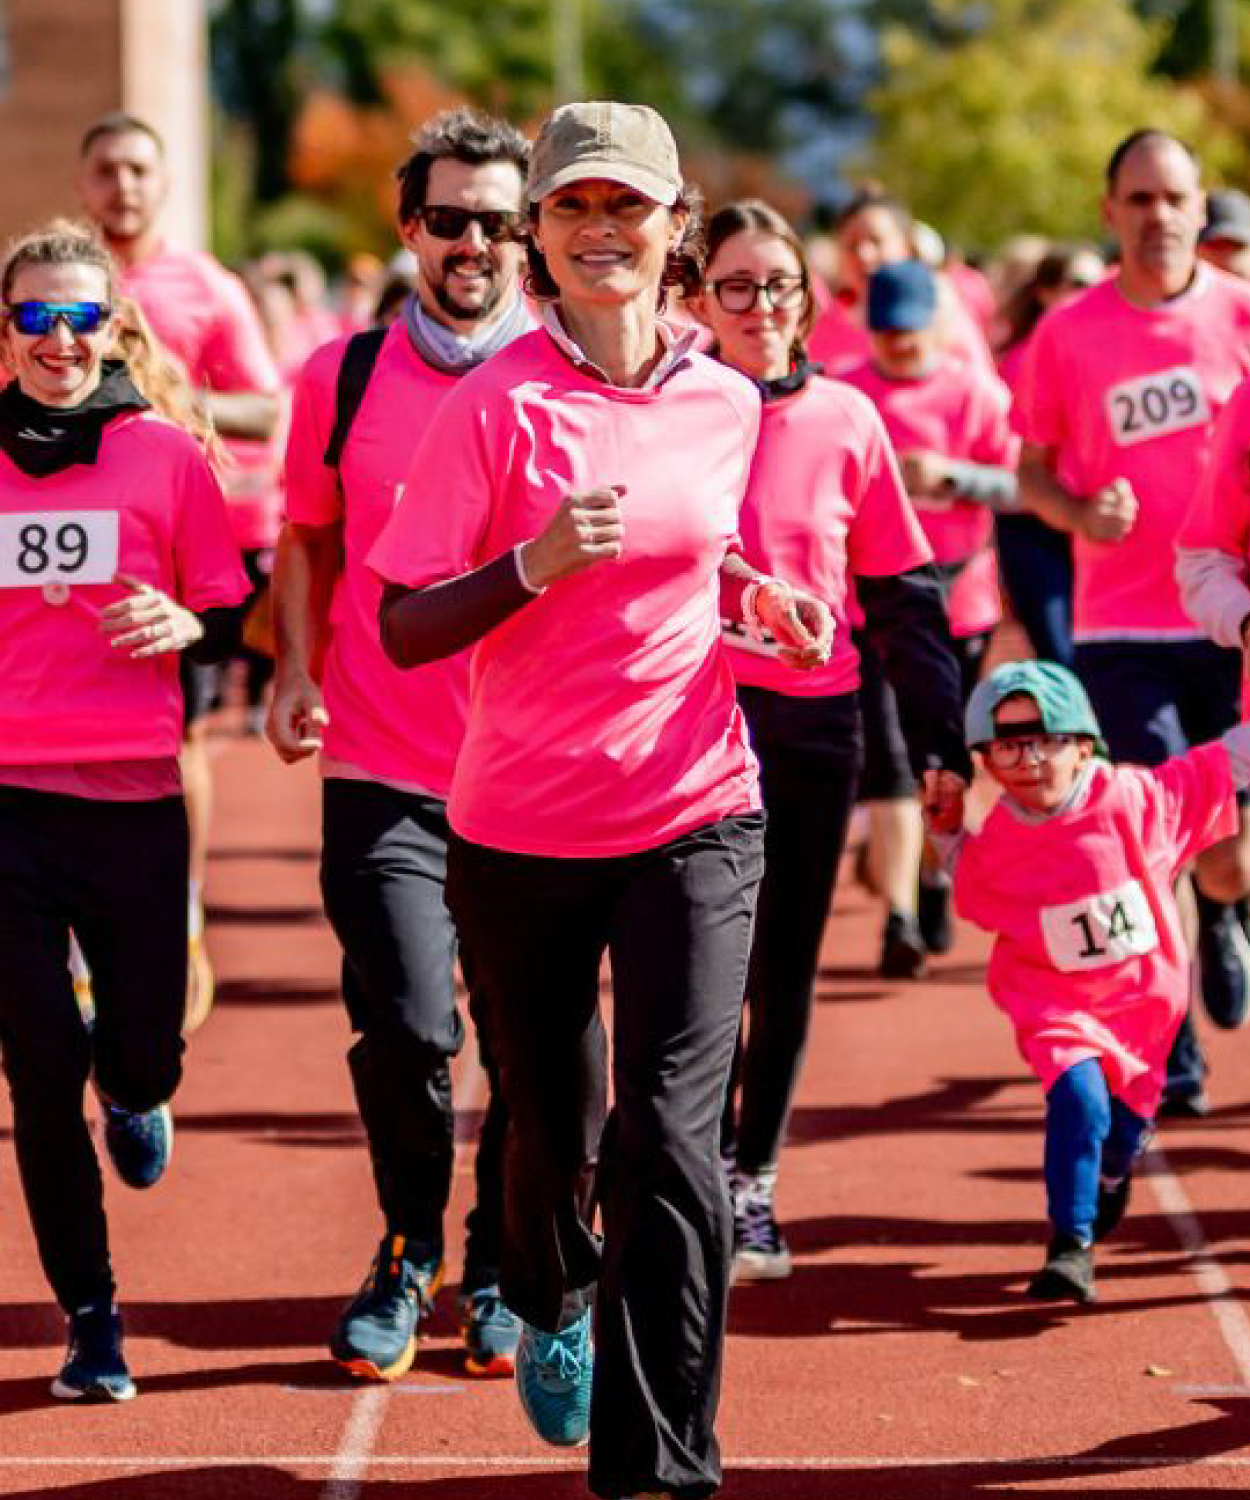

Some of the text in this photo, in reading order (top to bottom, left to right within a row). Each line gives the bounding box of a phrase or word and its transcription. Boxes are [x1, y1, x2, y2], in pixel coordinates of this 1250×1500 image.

[1115, 378, 1198, 434] 209
[17, 523, 88, 574] 89
[1071, 901, 1136, 959] 14
